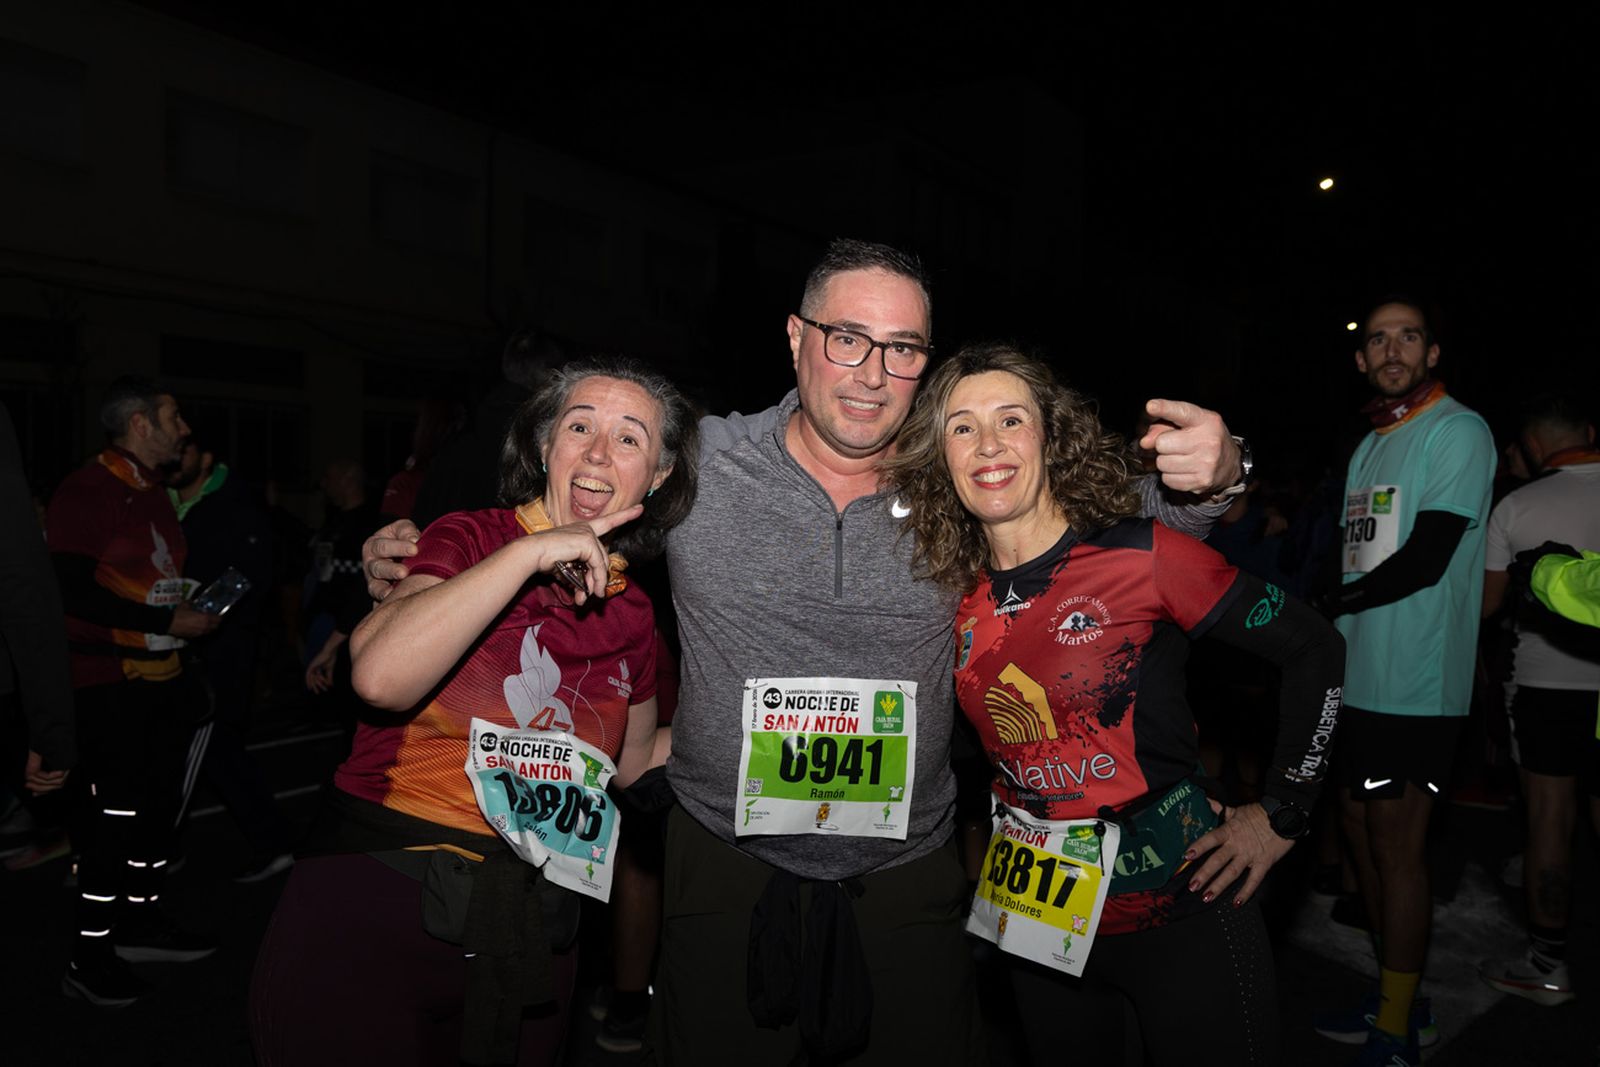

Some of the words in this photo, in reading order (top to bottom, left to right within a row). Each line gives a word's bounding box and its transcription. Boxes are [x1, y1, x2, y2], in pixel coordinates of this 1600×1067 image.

[1054, 627, 1104, 645] Martos
[764, 694, 781, 704] 43
[785, 695, 840, 711] NOCHE
[841, 698, 860, 712] DE
[763, 714, 799, 731] SAN
[802, 713, 859, 733] ANTÓN
[480, 736, 497, 748] 43
[500, 741, 551, 759] NOCHE
[553, 746, 573, 762] DE
[485, 755, 516, 773] SAN
[519, 761, 573, 781] ANTÓN
[779, 736, 883, 785] 6941
[999, 753, 1117, 790] Native
[810, 788, 845, 799] Ramón
[494, 771, 606, 842] 13806
[1111, 845, 1165, 879] CA
[986, 840, 1081, 909] 13817
[1004, 896, 1043, 918] Dolores
